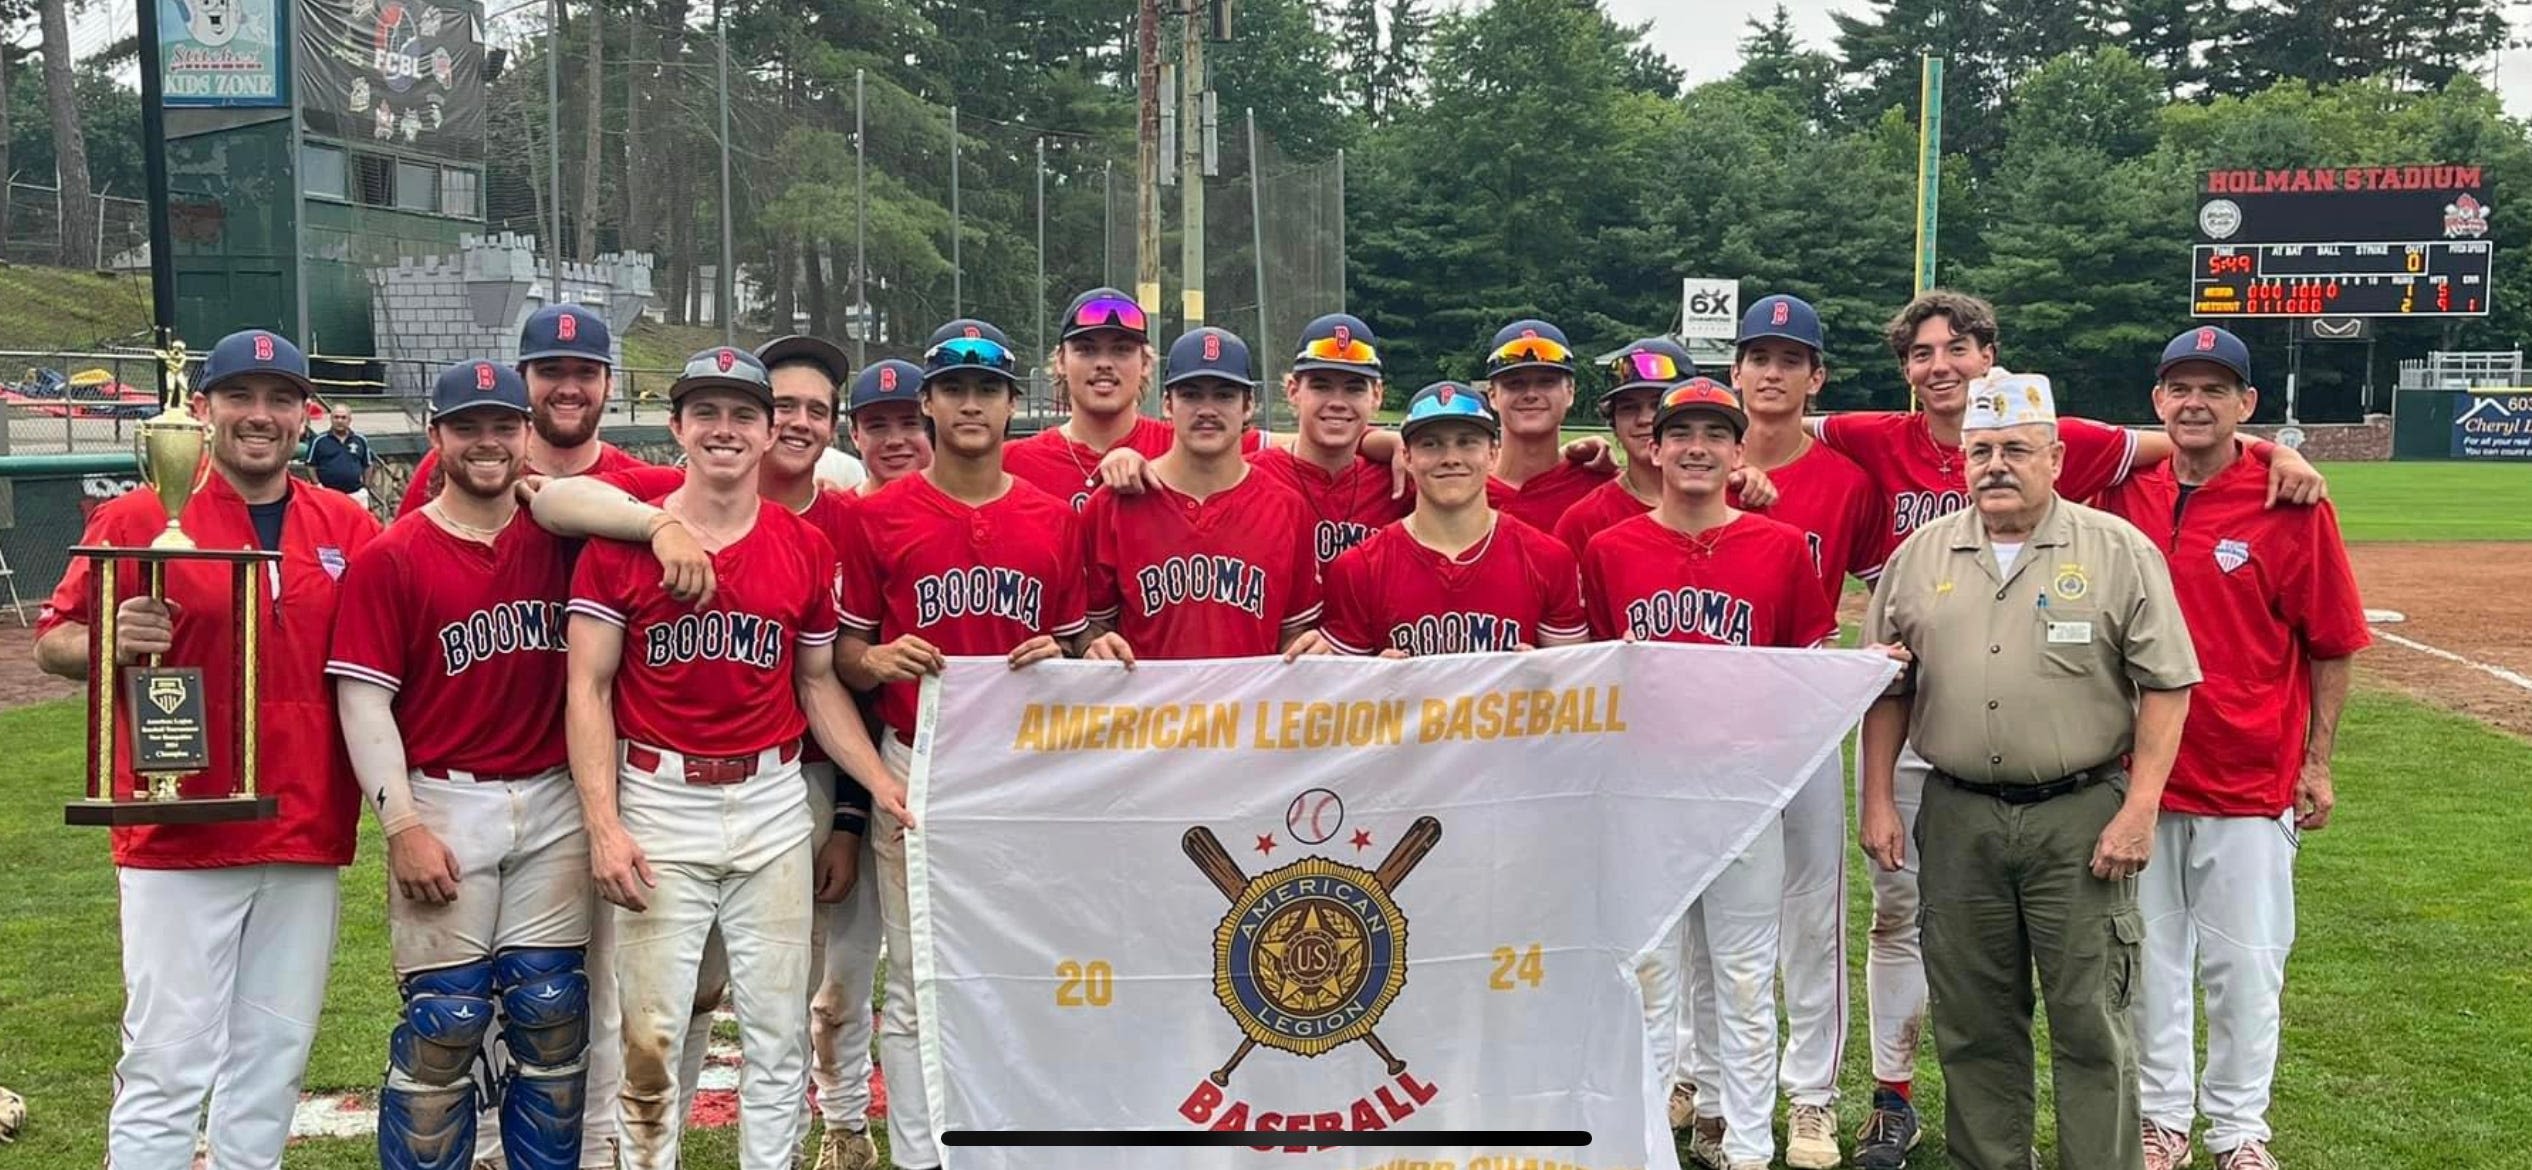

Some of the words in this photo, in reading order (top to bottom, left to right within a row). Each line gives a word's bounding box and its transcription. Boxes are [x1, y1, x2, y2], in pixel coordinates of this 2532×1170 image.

[373, 47, 424, 79] FCBL
[164, 74, 211, 95] KIDS
[213, 74, 273, 96] ZONE
[2207, 169, 2336, 193] HOLMAN
[2343, 166, 2482, 191] STADIUM
[2272, 246, 2283, 256] AT
[2285, 246, 2303, 256] BAT
[2316, 246, 2341, 256] BALL
[2355, 245, 2389, 255] STRIKE
[2404, 244, 2425, 254] OUT
[2208, 255, 2251, 274] 5:49
[2407, 254, 2420, 272] 0
[1689, 293, 1731, 315] 6X
[1771, 301, 1789, 325] B
[558, 313, 576, 340] B
[2196, 326, 2217, 351] B
[254, 335, 274, 361] B
[1203, 333, 1221, 361] B
[474, 361, 496, 391] B
[879, 367, 897, 392] B
[2464, 417, 2521, 436] Cheryl
[1893, 490, 1974, 535] BOO
[915, 566, 1042, 631] BOOMA
[1137, 554, 1265, 619] BOOMA
[1628, 587, 1752, 647] BOOMA
[646, 611, 783, 669] BOOMA
[1389, 611, 1520, 657] BOOMA
[1013, 701, 1242, 752] AMERICAN
[1253, 698, 1406, 750] LEGION
[1418, 685, 1627, 744] BASEBALL
[1241, 879, 1385, 941] AMERICAN
[1489, 944, 1544, 990] 24
[1055, 960, 1113, 1007] 20
[1257, 999, 1365, 1036] LEGION
[1176, 1071, 1440, 1154] BASEBALL
